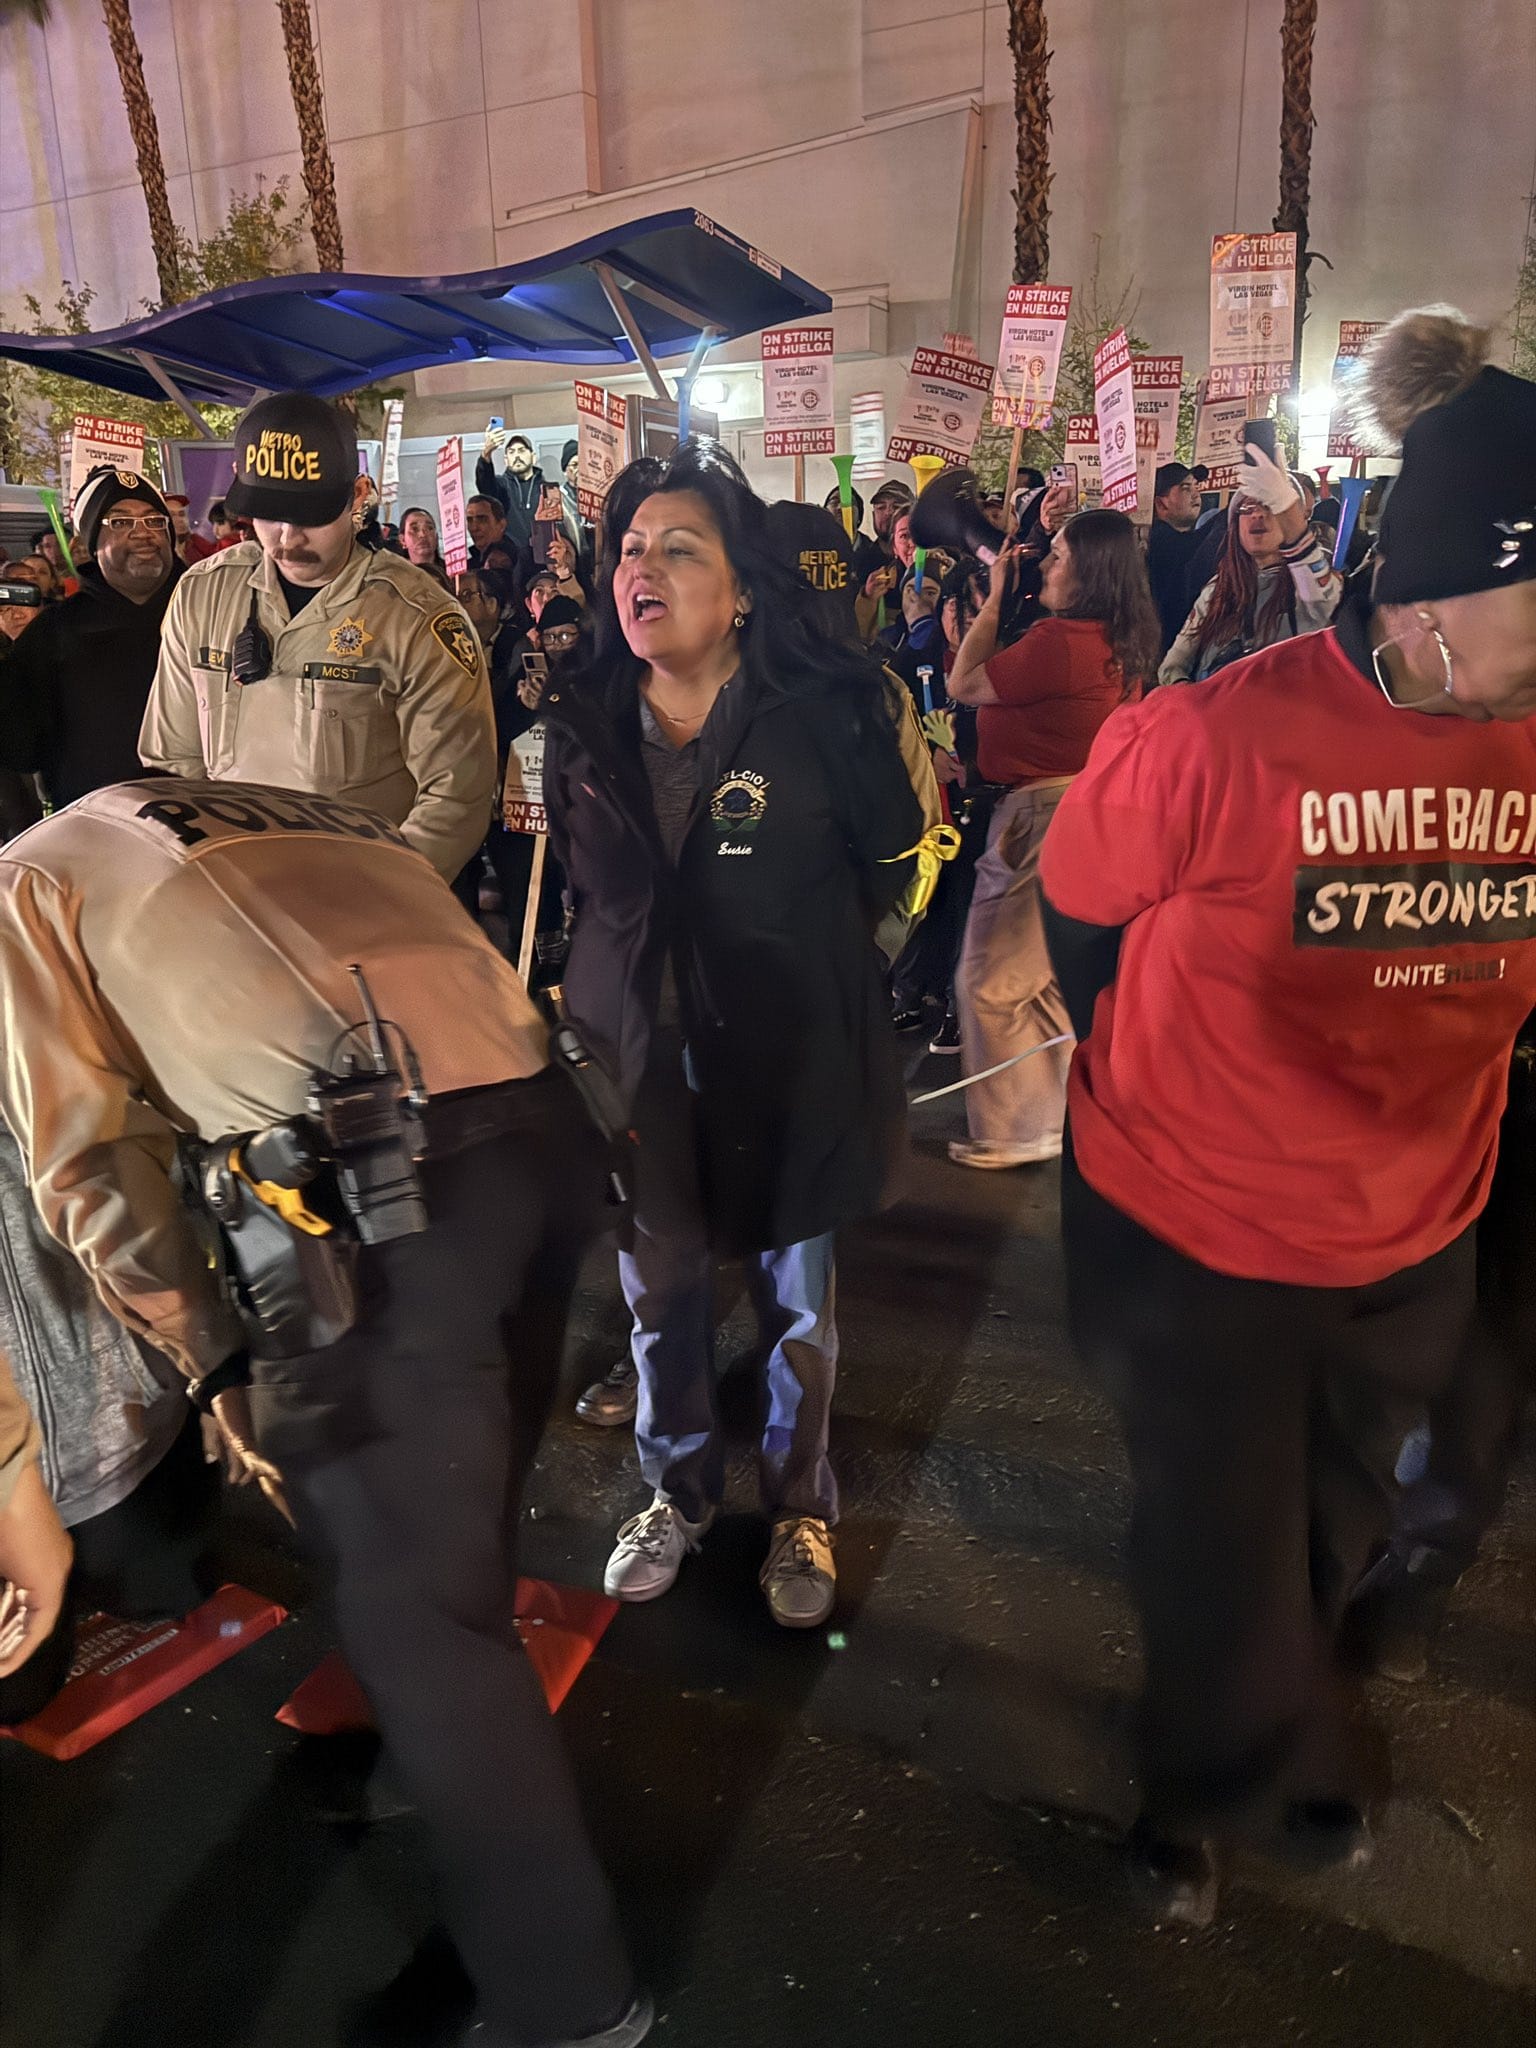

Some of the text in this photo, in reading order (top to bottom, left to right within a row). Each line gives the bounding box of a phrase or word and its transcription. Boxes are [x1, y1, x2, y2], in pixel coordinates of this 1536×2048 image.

[1241, 238, 1294, 252] STRIKE
[1238, 253, 1294, 268] HUELGA
[1008, 290, 1070, 303] ON STRIKE
[1250, 290, 1273, 298] VEGAS
[1006, 303, 1067, 316] EN HUELGA
[763, 331, 833, 345] ON STRIKE
[763, 342, 831, 356] EN HUELGA
[916, 351, 937, 364] ON
[941, 356, 992, 379] STRIKE
[1132, 360, 1181, 373] TRIKE
[1211, 363, 1291, 381] ON STRIKE
[913, 362, 932, 374] EN
[935, 366, 988, 389] HUELGA
[1132, 373, 1180, 386] UELGA
[1212, 378, 1290, 395] EN HUELGA
[576, 384, 625, 414] ON SIKE
[577, 396, 591, 410] EN
[74, 416, 144, 437] ON STRIKE
[1069, 417, 1093, 429] ON
[74, 426, 143, 446] EN HUELGA
[260, 429, 302, 452] METRO
[765, 430, 833, 444] ON STRIKE
[1068, 429, 1090, 441] EN
[766, 441, 833, 455] EN HUELGA
[888, 449, 907, 461] EN
[891, 438, 912, 451] ON
[915, 443, 968, 466] STRIKE
[1328, 447, 1343, 456] EN
[245, 443, 321, 480] POLICE
[578, 490, 591, 505] ON
[578, 502, 590, 517] EN
[322, 665, 359, 681] MCST
[720, 770, 764, 785] FL-CIO
[505, 804, 525, 817] ON
[136, 797, 417, 848] POLICE
[505, 817, 520, 829] EN
[1301, 787, 1439, 856] COME
[718, 842, 752, 855] Susie
